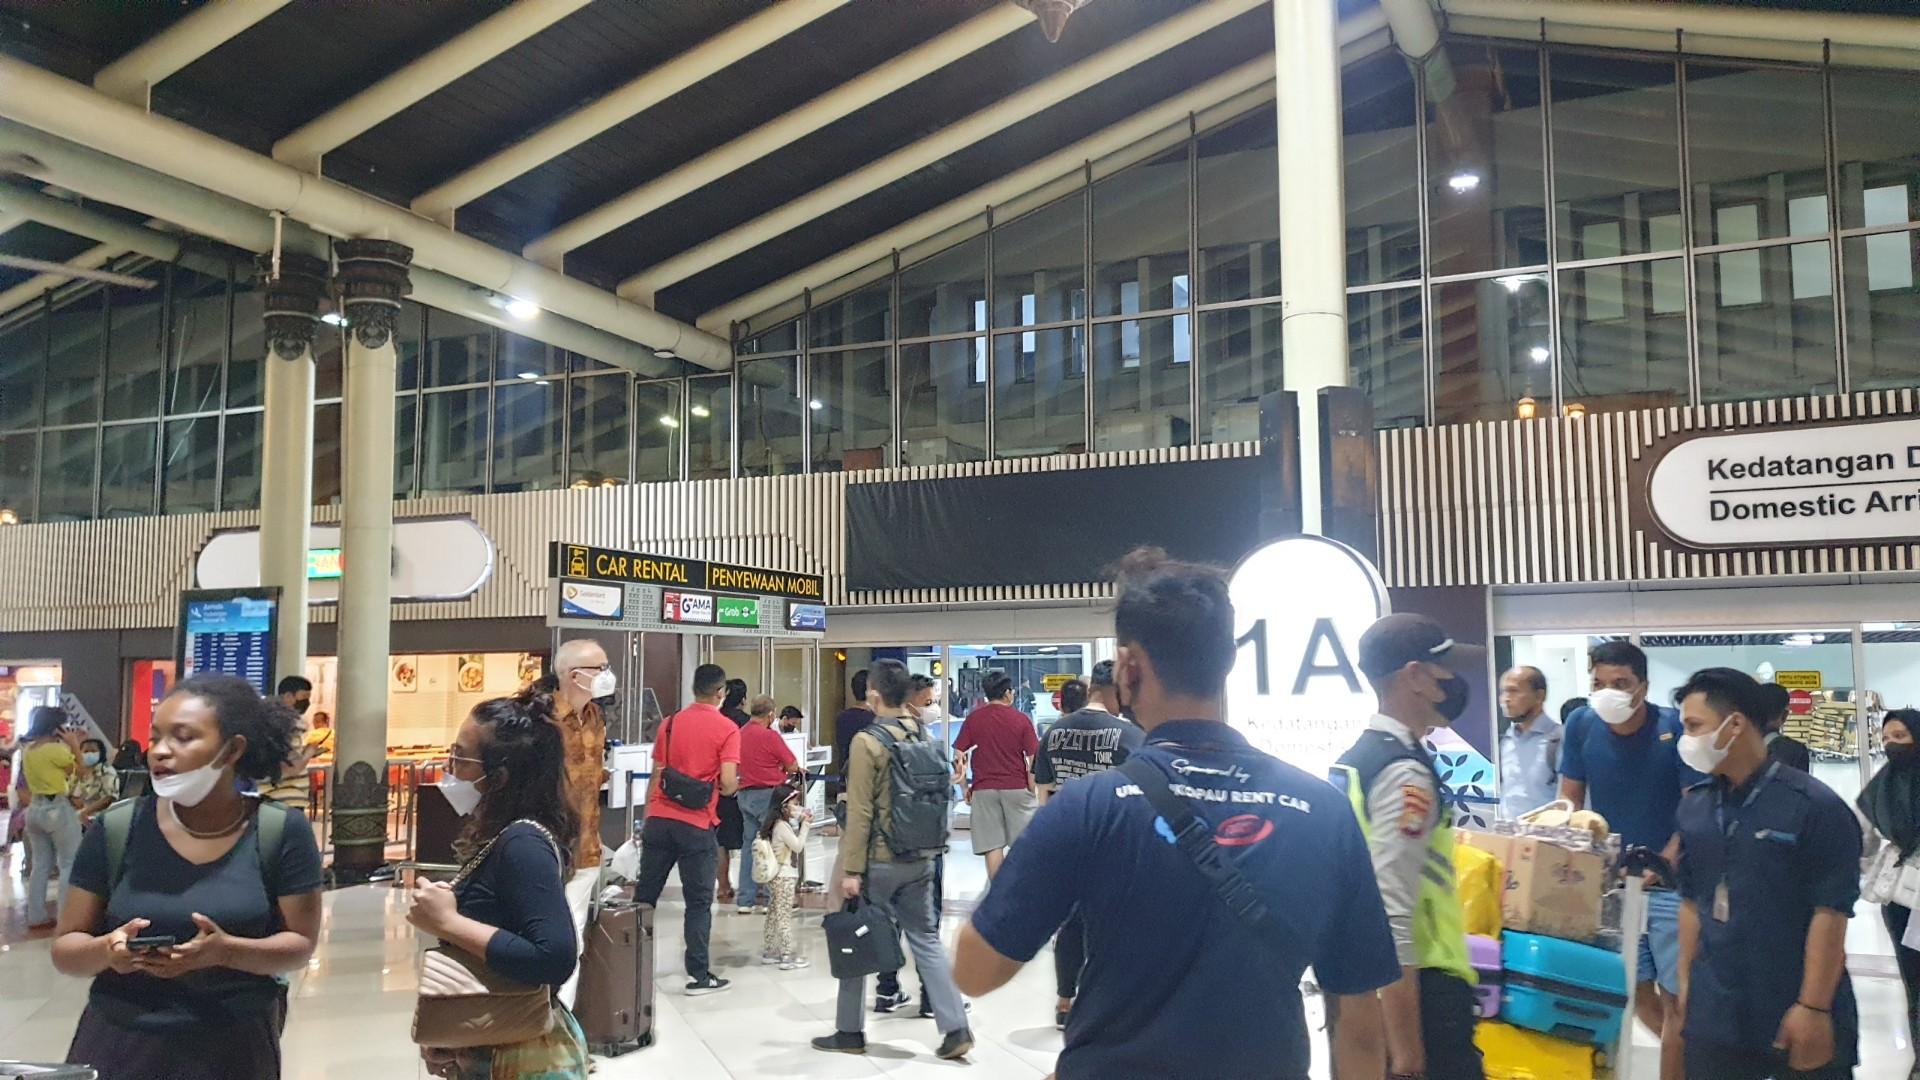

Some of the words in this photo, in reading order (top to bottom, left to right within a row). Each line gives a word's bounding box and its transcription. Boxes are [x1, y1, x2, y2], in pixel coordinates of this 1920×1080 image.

[1709, 452, 1894, 480] Kedatangan
[1711, 494, 1855, 521] Domestic
[596, 555, 626, 575] CAR
[633, 560, 688, 583] RENTAL
[712, 567, 785, 592] PENYEWAAN
[787, 575, 820, 596] MOBIL
[724, 606, 740, 617] Grab
[1247, 713, 1362, 735] Kedatangan
[1231, 790, 1277, 805] RENT
[1278, 795, 1311, 814] CAR
